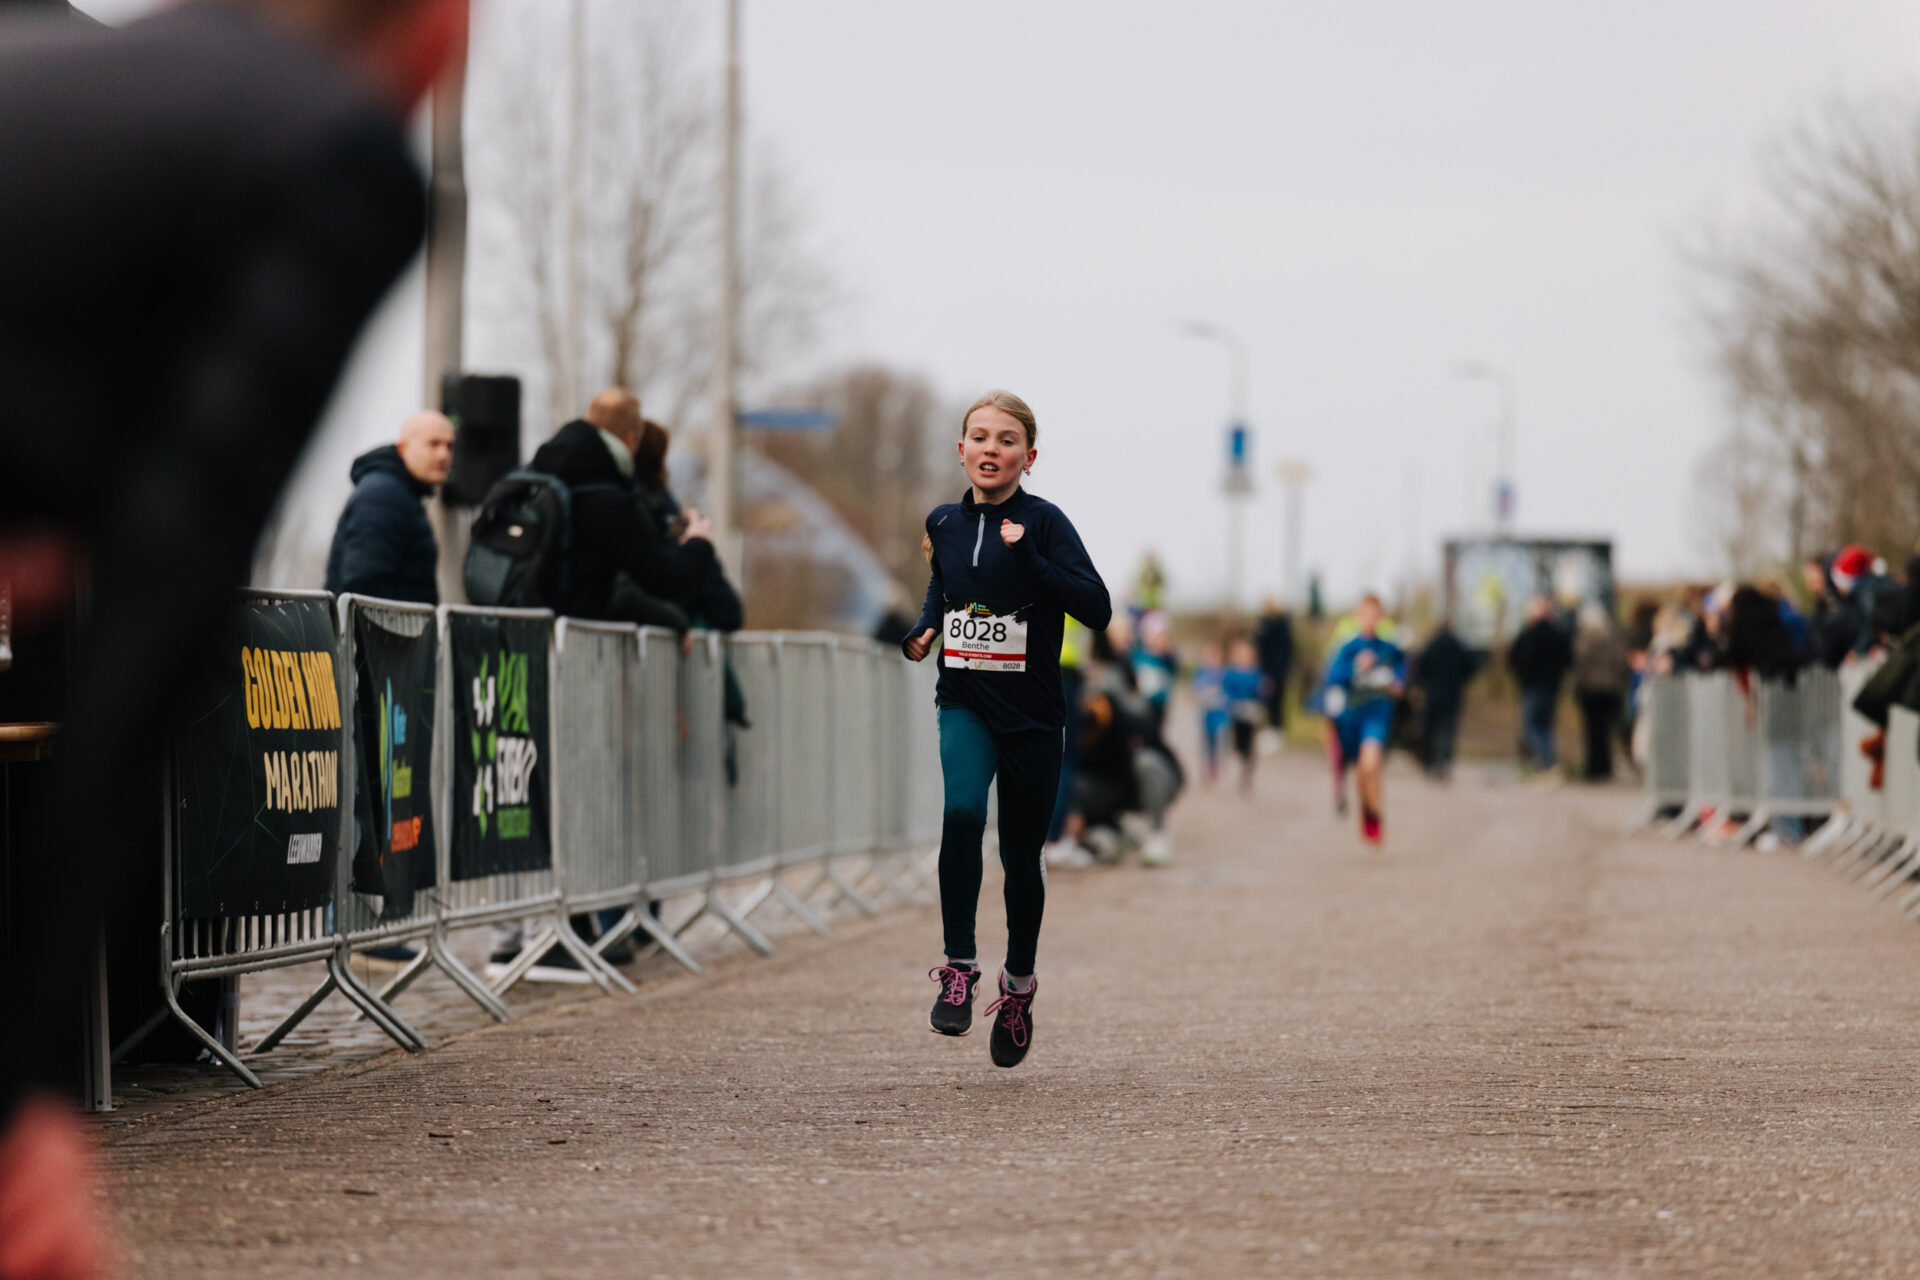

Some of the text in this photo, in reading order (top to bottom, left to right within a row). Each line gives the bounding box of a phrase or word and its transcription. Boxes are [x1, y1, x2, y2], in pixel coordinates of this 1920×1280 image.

[950, 618, 1007, 642] 8028
[962, 641, 990, 651] Benthe
[242, 646, 310, 729] GOLDEN
[264, 750, 338, 813] MARATHON
